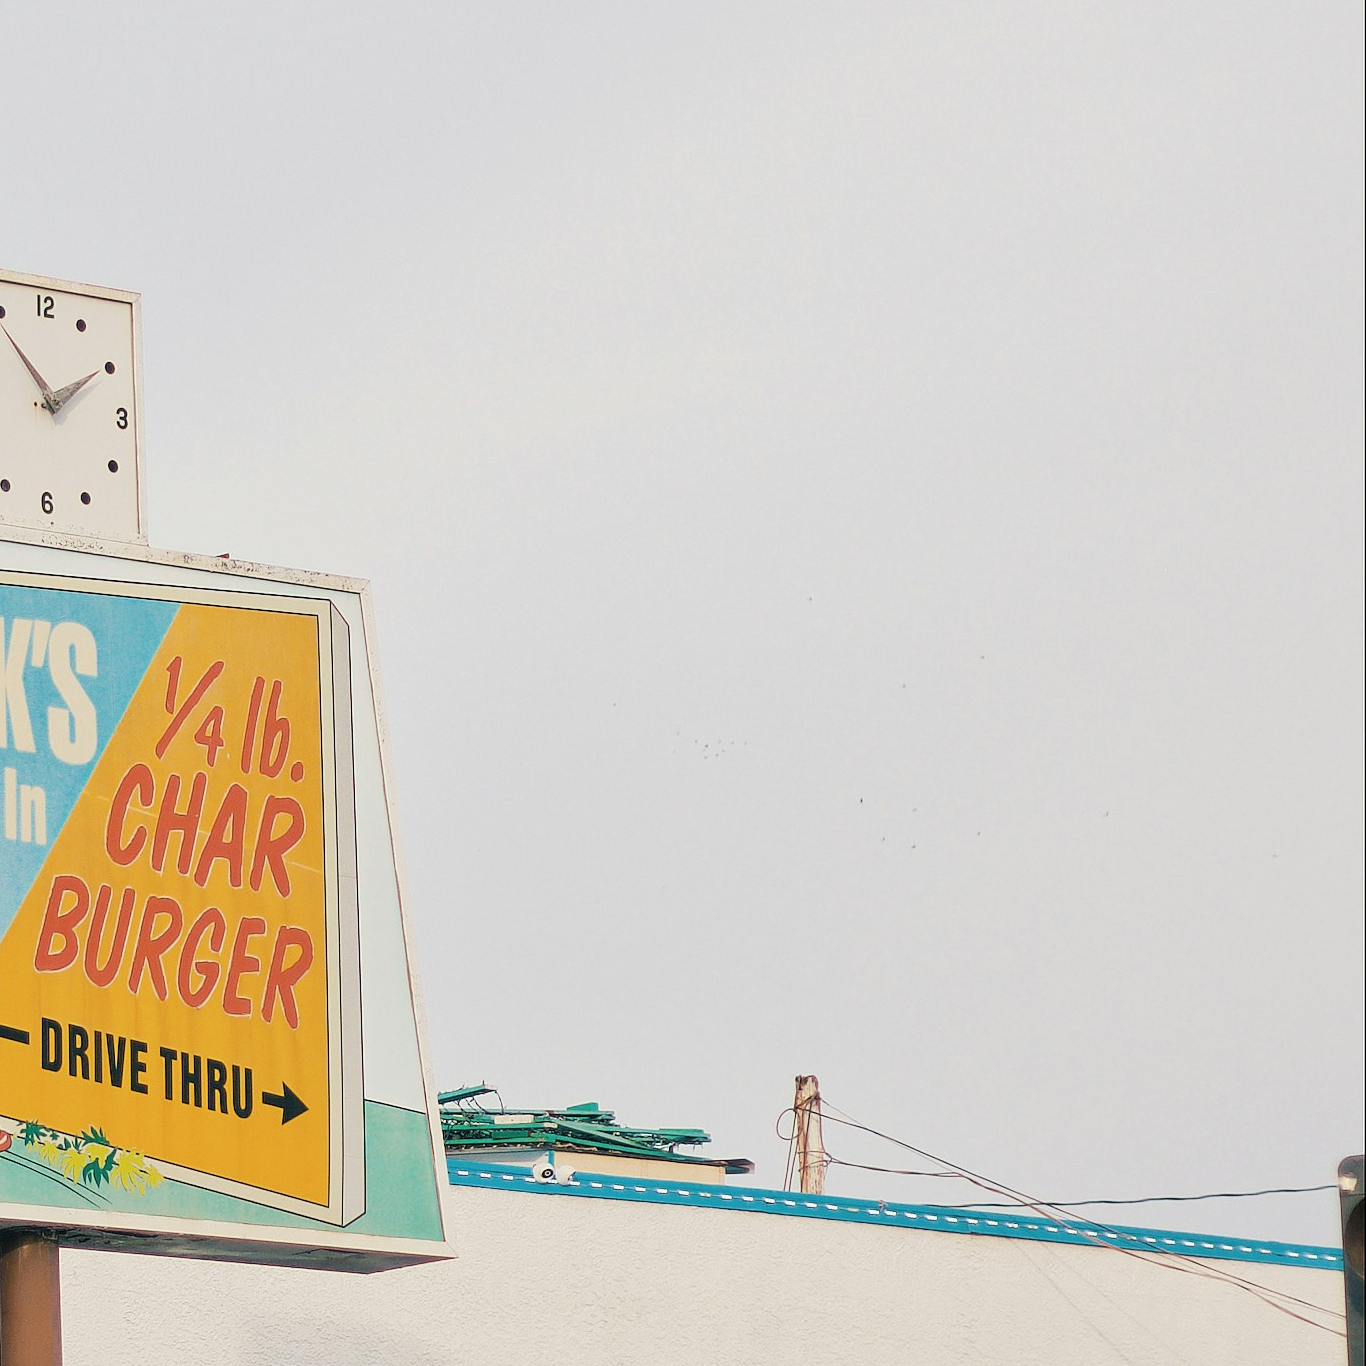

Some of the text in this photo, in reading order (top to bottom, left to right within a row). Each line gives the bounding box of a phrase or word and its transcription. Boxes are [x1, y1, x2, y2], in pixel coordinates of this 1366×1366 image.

[36, 295, 55, 320] 12
[116, 406, 129, 431] 3
[40, 491, 54, 515] 6
[241, 675, 305, 784] lb.
[4, 765, 48, 846] In
[104, 762, 306, 899] CHAR
[34, 874, 314, 1030] BURGER
[40, 1016, 254, 1120] DRIVE THRU
